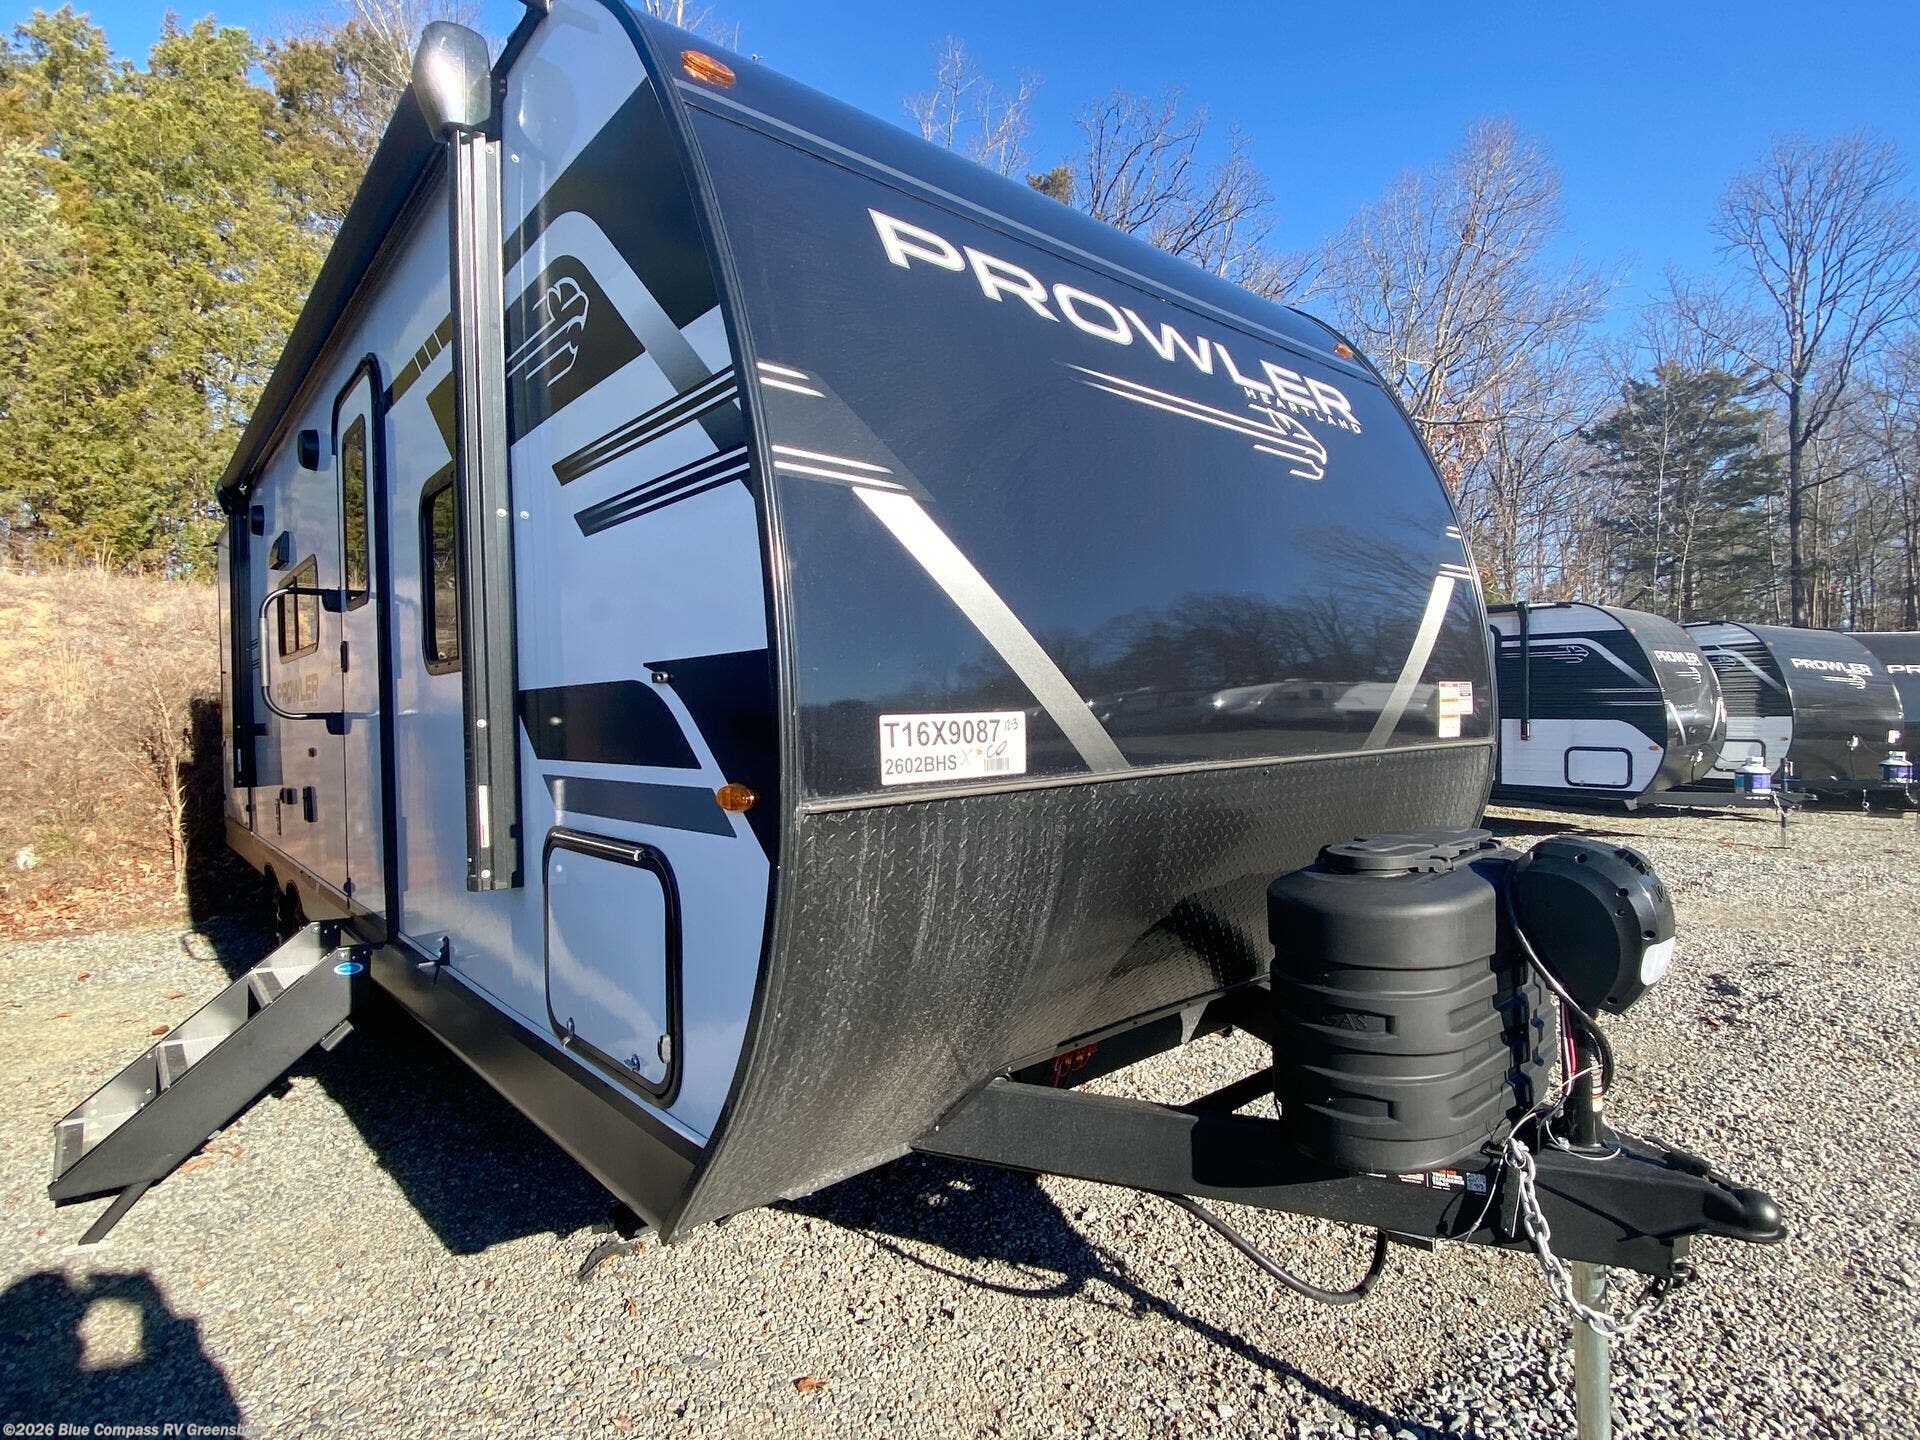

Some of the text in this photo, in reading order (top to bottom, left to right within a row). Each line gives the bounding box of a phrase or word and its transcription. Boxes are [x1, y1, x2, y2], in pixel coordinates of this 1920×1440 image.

[868, 208, 1361, 426] PROWLER
[1244, 386, 1362, 434] HEARTLAND
[1653, 650, 1700, 663] PROWLER
[1790, 658, 1873, 676] PROWLER
[884, 719, 1001, 748] T16X9087
[885, 755, 957, 775] 2602BHS
